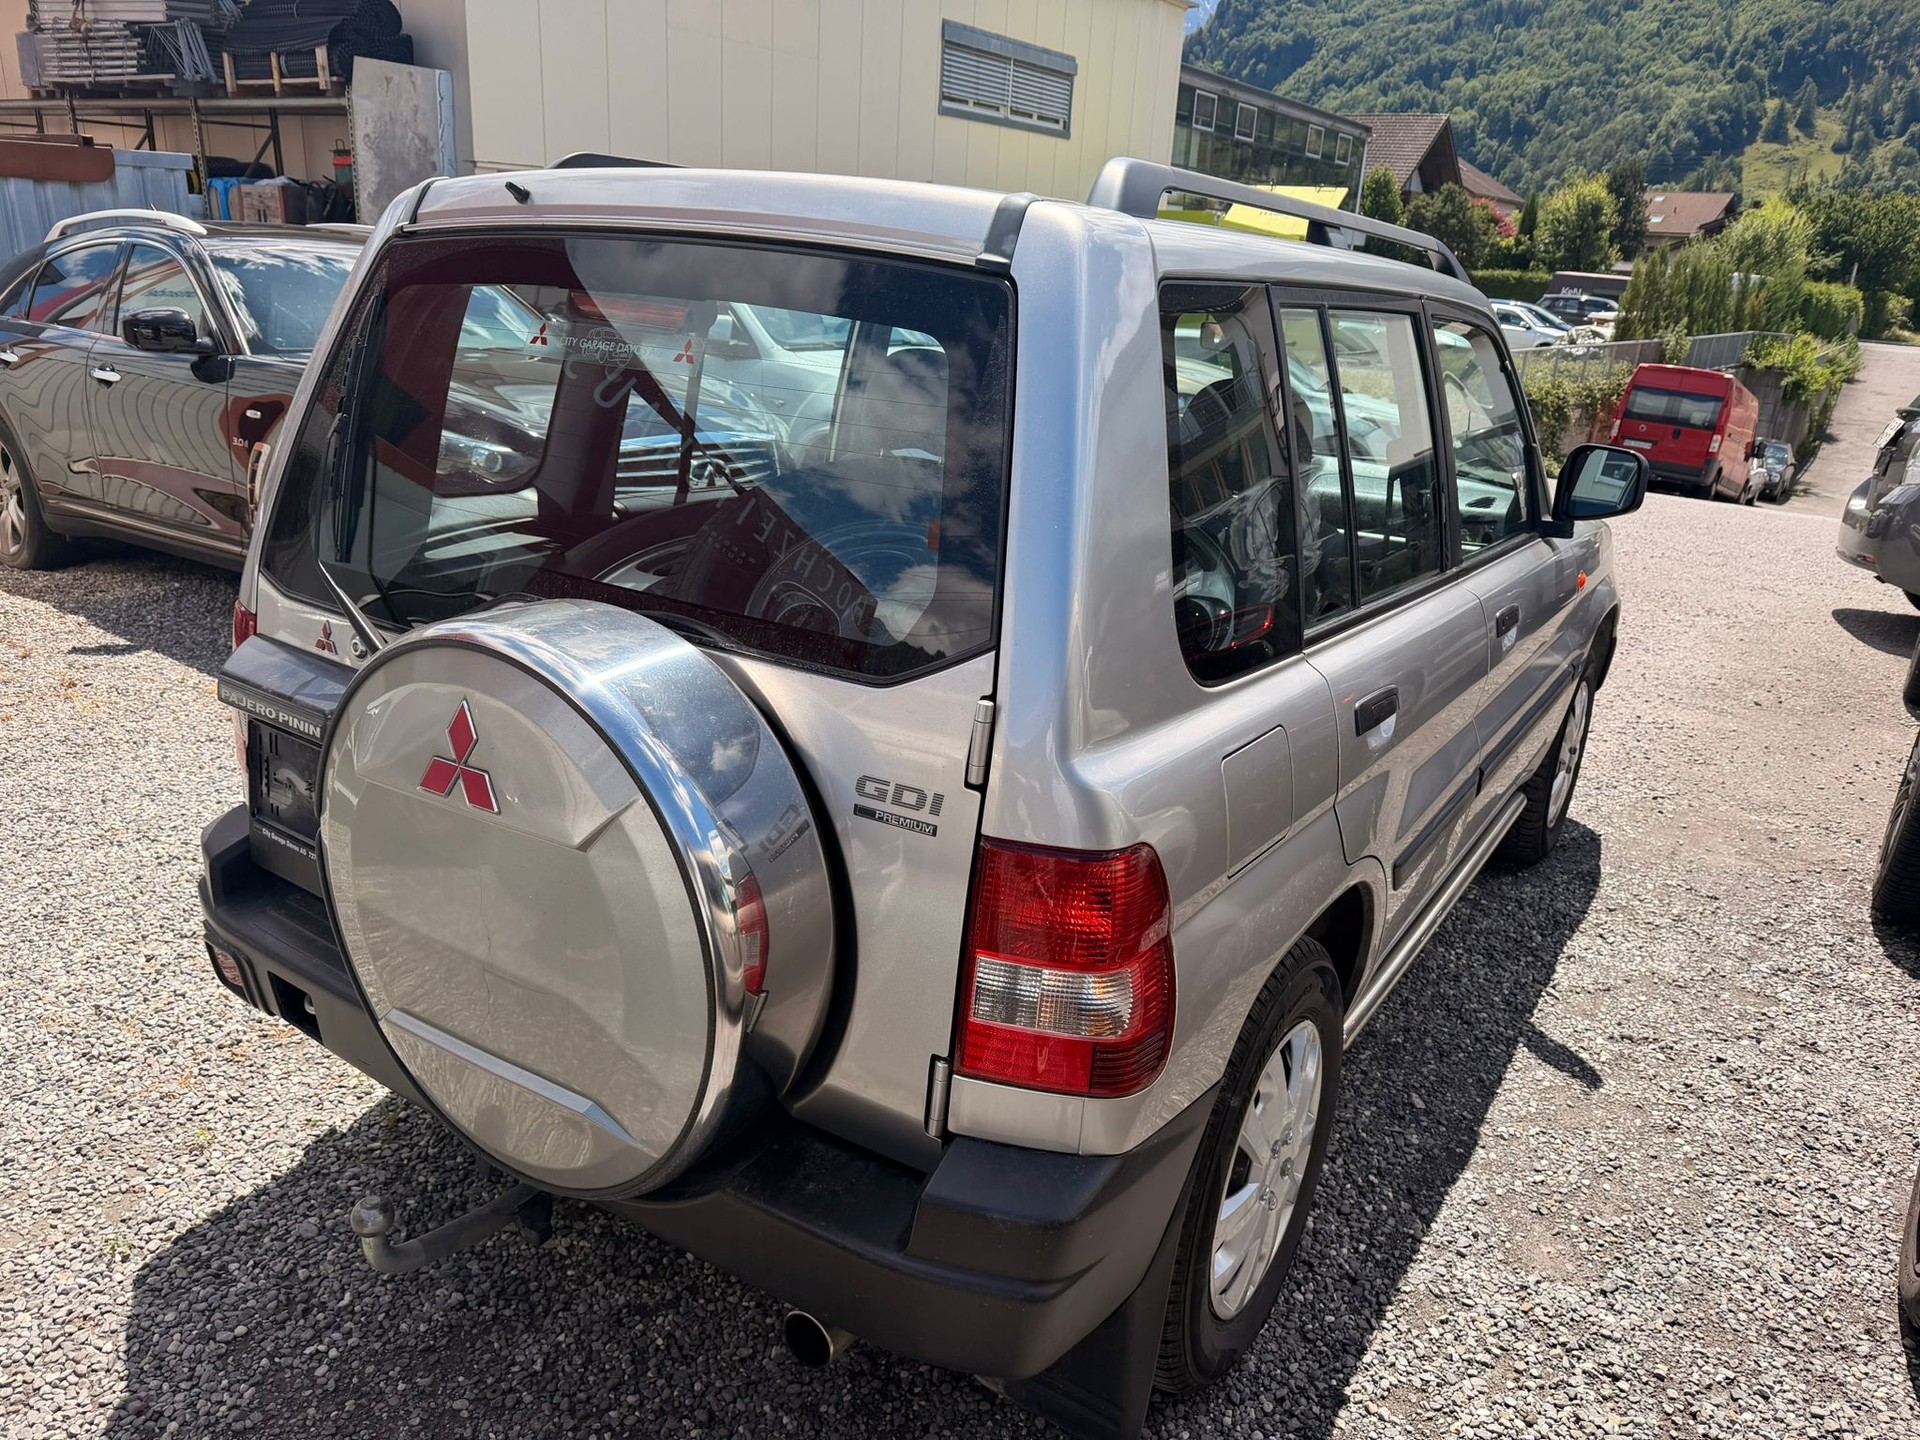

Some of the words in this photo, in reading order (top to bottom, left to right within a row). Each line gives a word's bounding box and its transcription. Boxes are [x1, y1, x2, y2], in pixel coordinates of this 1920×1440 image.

[561, 336, 578, 347] CITY
[580, 338, 615, 352] GARAGE
[221, 689, 277, 719] PAJERO
[278, 712, 321, 739] PININ
[855, 775, 945, 817] GDI
[875, 810, 934, 836] PREMIUM
